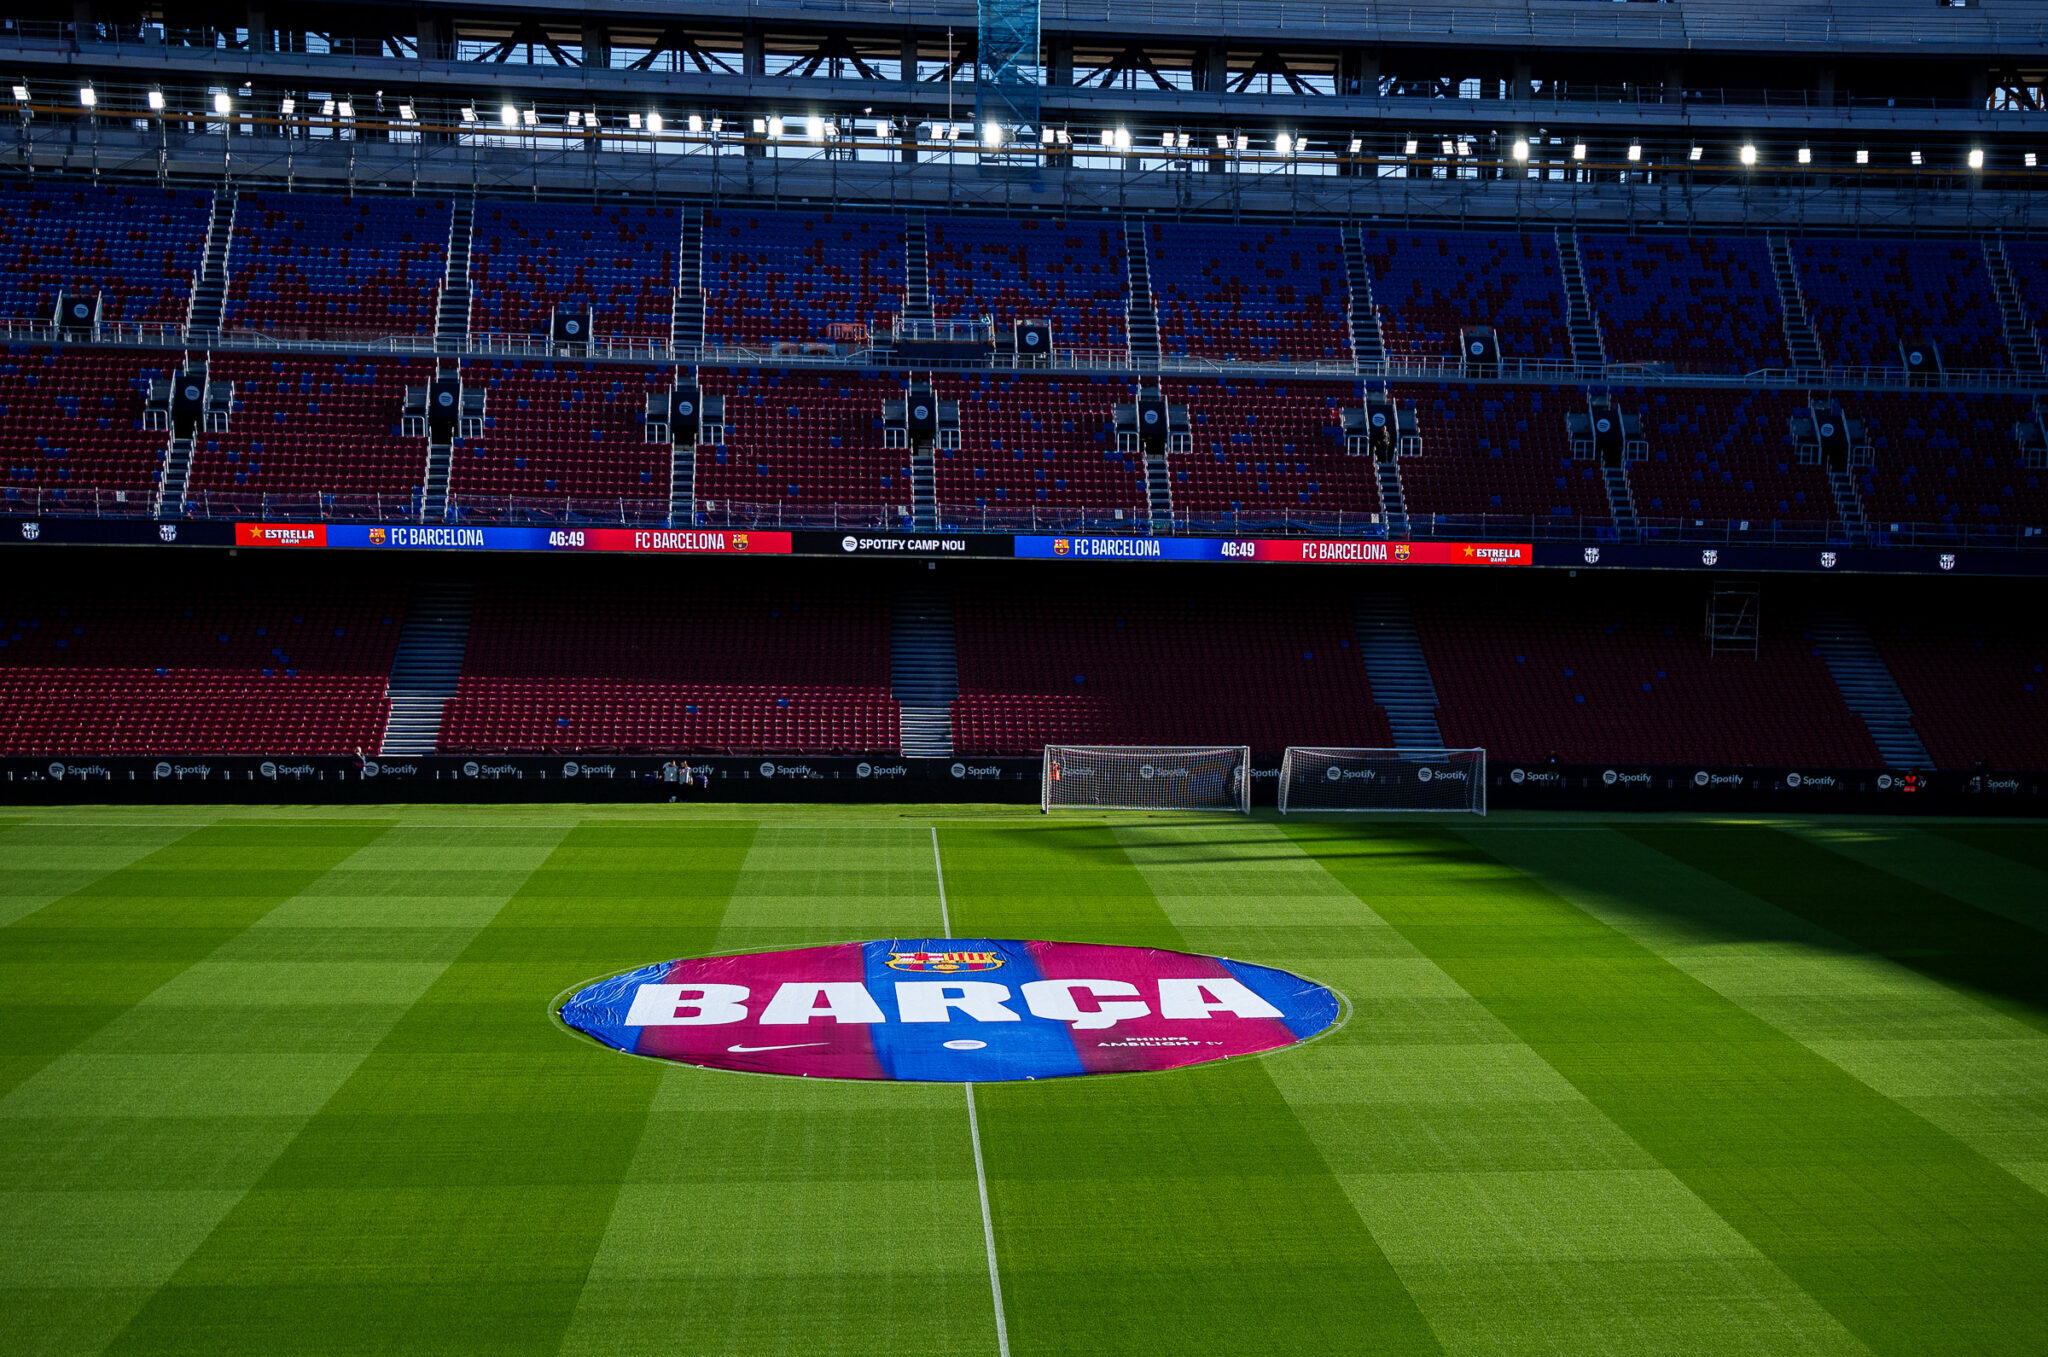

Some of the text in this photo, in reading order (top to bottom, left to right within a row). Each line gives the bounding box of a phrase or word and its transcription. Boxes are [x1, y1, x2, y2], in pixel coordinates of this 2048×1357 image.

[264, 529, 315, 540] ESTRELLA
[391, 528, 484, 546] FC BARCELONA
[549, 531, 585, 547] 46:49
[635, 531, 725, 550] FC BARCELONA
[859, 538, 966, 551] SPOTIFY CAMP NOU
[1074, 538, 1161, 557] FC BARCELONA
[1221, 541, 1255, 557] 46:49
[1302, 542, 1388, 560] FC BARCELONA
[1476, 548, 1521, 559] ESTRELLA
[67, 764, 106, 776] Spotify
[174, 764, 211, 776] Spotify
[278, 764, 315, 776] Spotify
[381, 764, 418, 776] Spotify
[481, 764, 517, 776] Spotify
[581, 764, 616, 776] Spotify
[776, 764, 812, 776] Spotify
[873, 765, 908, 776] Spotify
[967, 766, 1001, 777] Spotify
[1342, 769, 1376, 780] Spotify
[1434, 770, 1468, 781] Spotify
[1618, 773, 1652, 783] Spotify
[1710, 774, 1744, 785] Spotify
[1803, 775, 1836, 787] Spotify
[625, 977, 1286, 1030] BARÇA
